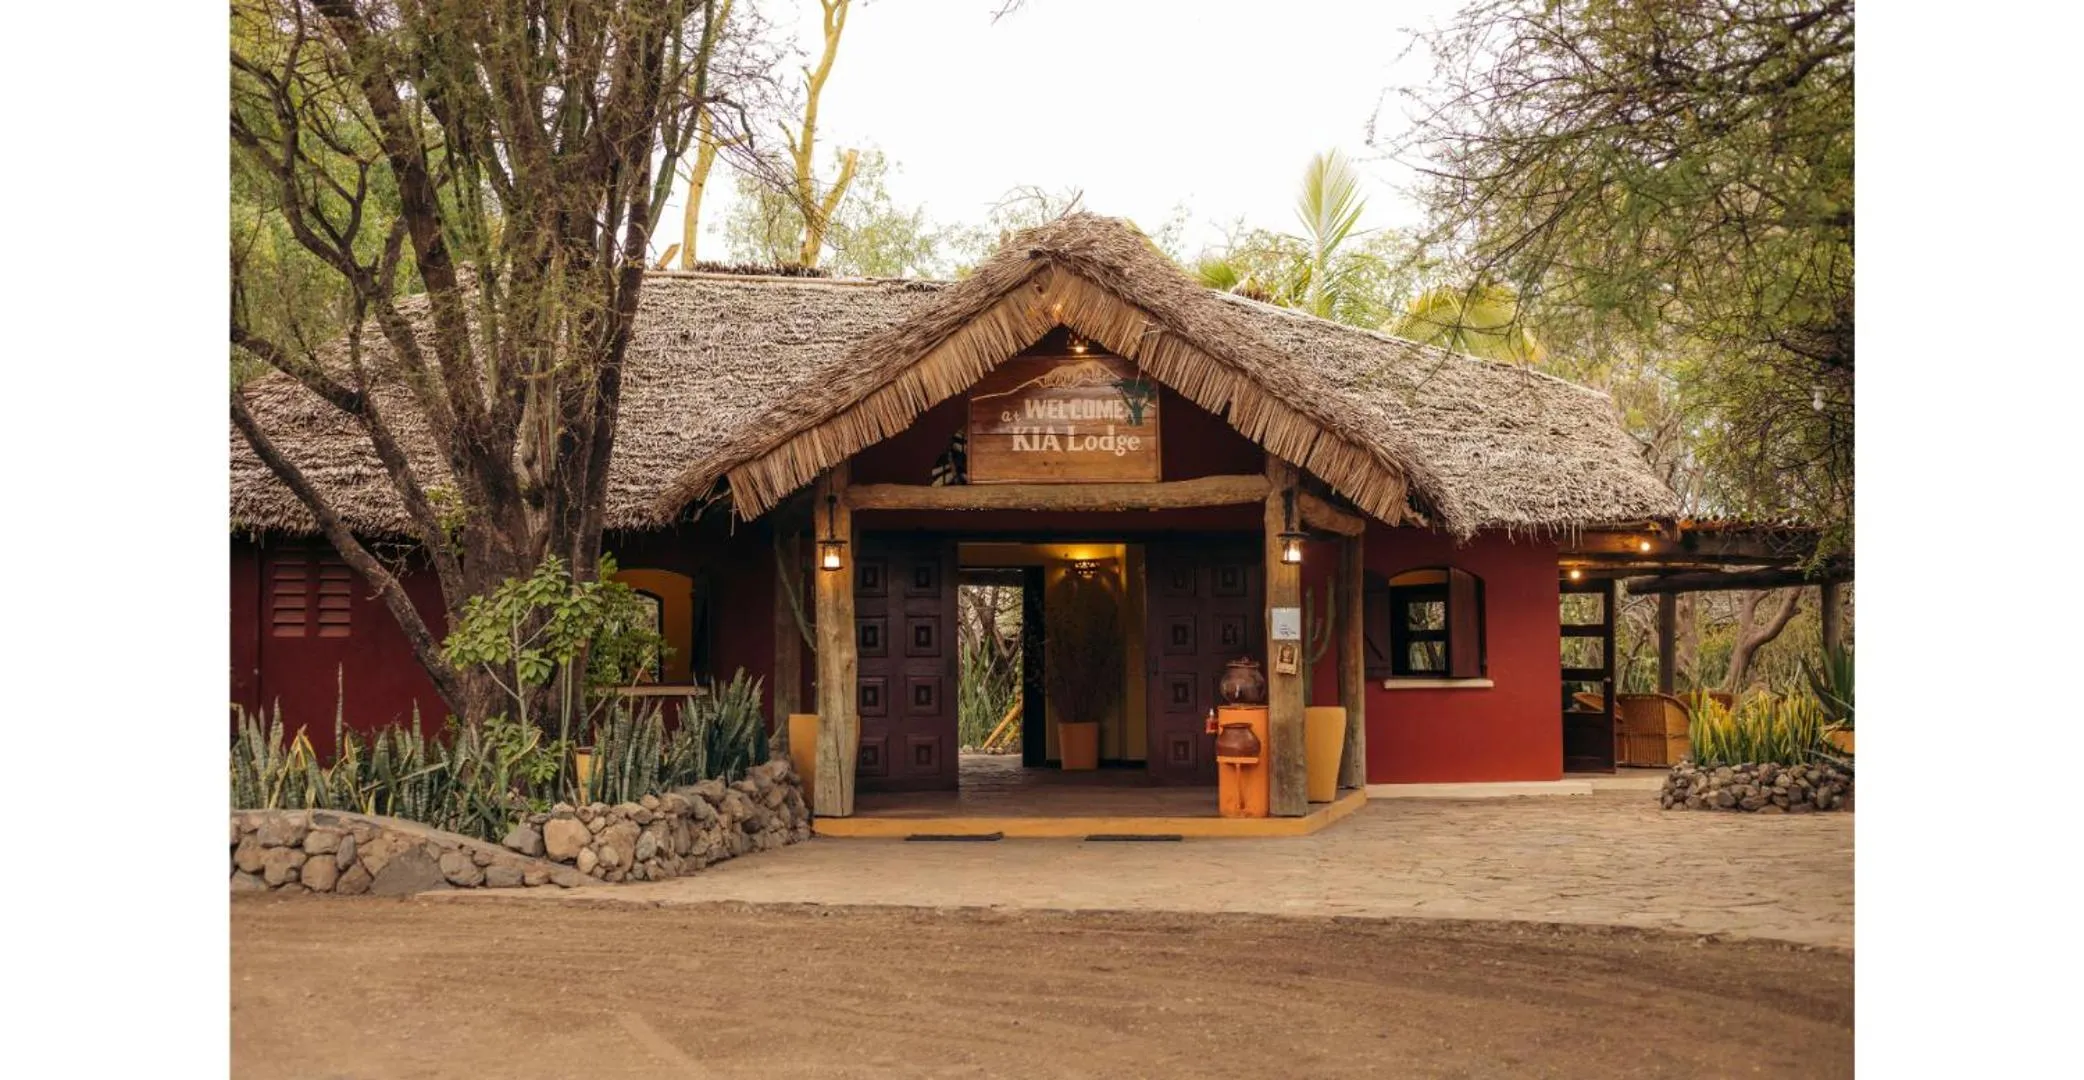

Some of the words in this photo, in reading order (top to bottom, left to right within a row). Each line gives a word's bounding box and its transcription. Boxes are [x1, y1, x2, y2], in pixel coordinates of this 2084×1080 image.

[1001, 410, 1021, 422] at
[1024, 398, 1125, 419] WELCOME
[1012, 425, 1062, 452] KIA
[1067, 424, 1140, 456] Lodge
